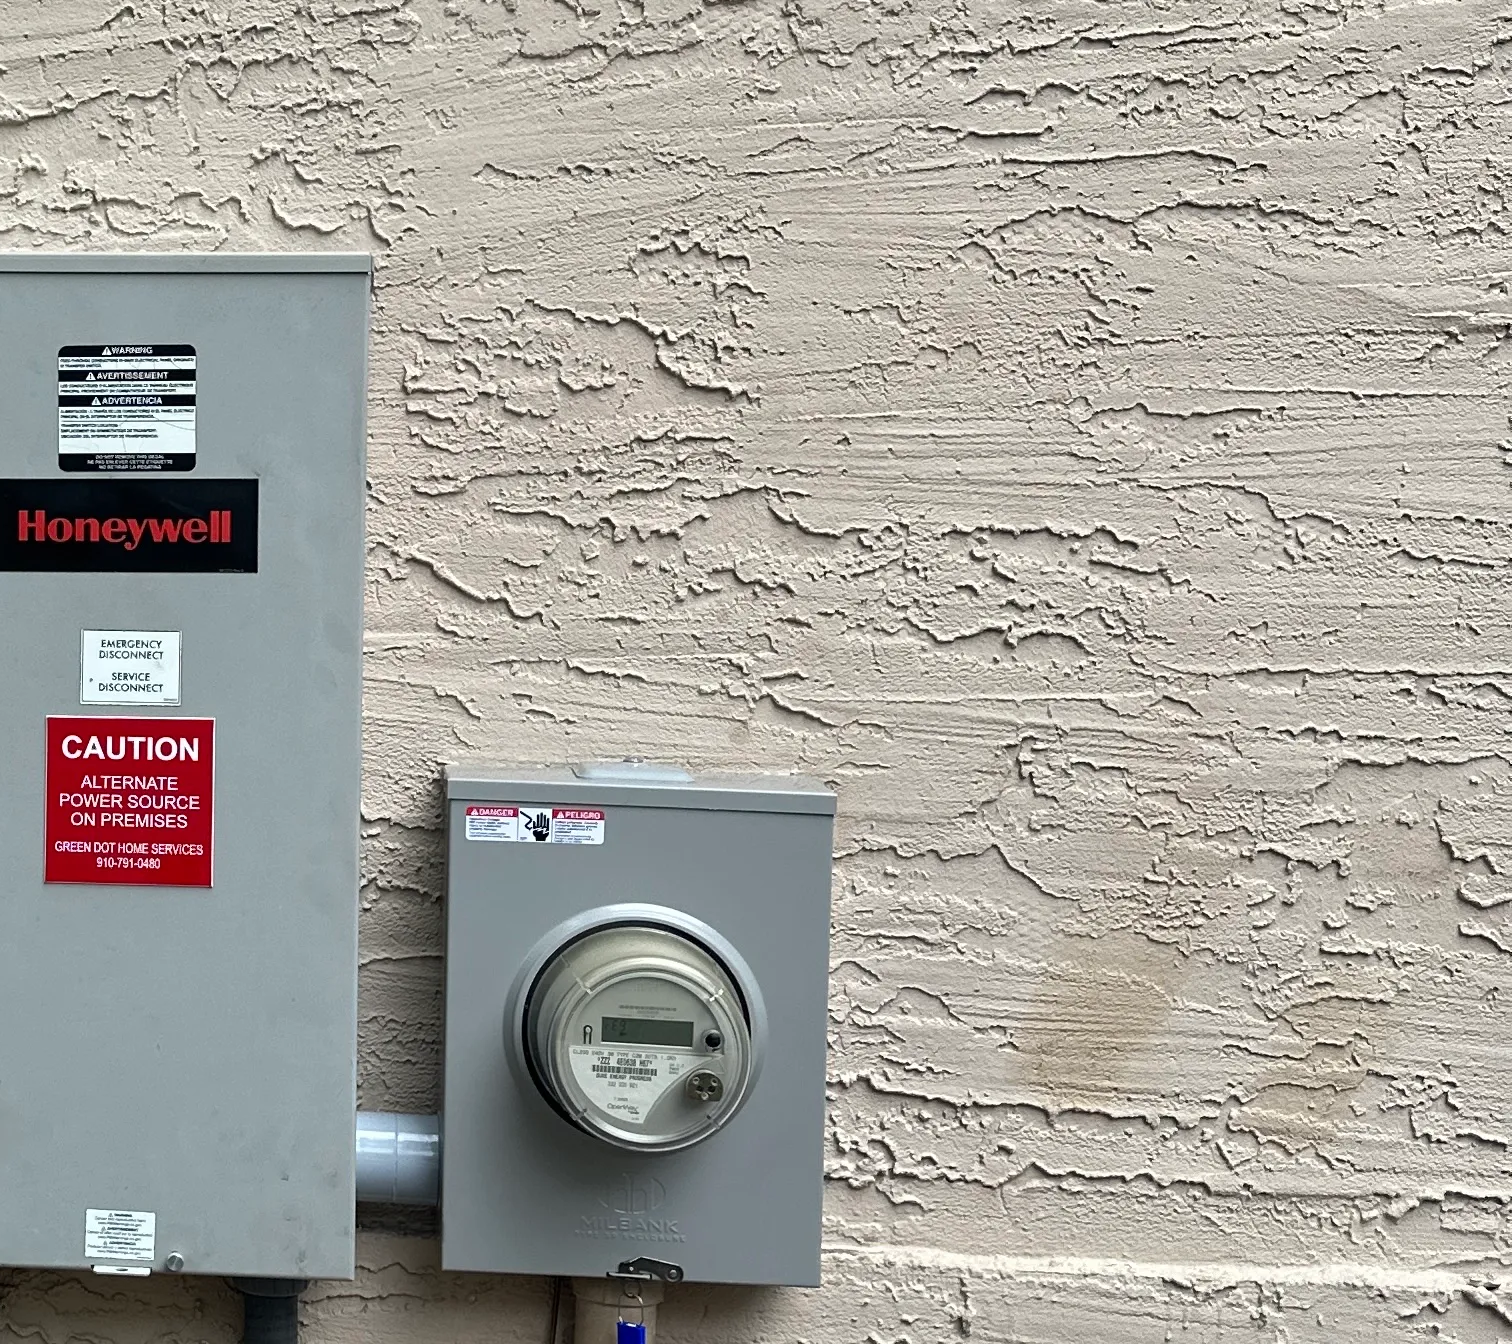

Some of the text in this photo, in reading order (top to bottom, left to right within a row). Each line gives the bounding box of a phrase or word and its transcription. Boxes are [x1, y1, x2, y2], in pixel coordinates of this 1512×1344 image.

[111, 346, 153, 354] WARNING
[97, 371, 169, 380] AVERTISSEMENT
[102, 396, 163, 405] ADVERTENCIA
[18, 509, 231, 551] Honeywell
[100, 639, 162, 649] EMERGENCY
[98, 650, 164, 660] DISCONNECT
[111, 672, 151, 682] SERVICE
[98, 683, 163, 693] DISCONNECT
[61, 734, 199, 762] CAUTION
[80, 775, 178, 791] ALTERNATE
[59, 793, 200, 810] POWER SOURCE
[479, 808, 514, 817] DANGER
[565, 811, 601, 820] PELIGRO
[70, 811, 188, 829] ON PREMISES
[54, 840, 204, 856] GREEN DOT HOME SERVICES
[96, 856, 161, 869] 910-791-0480
[579, 1215, 678, 1234] MILBANK
